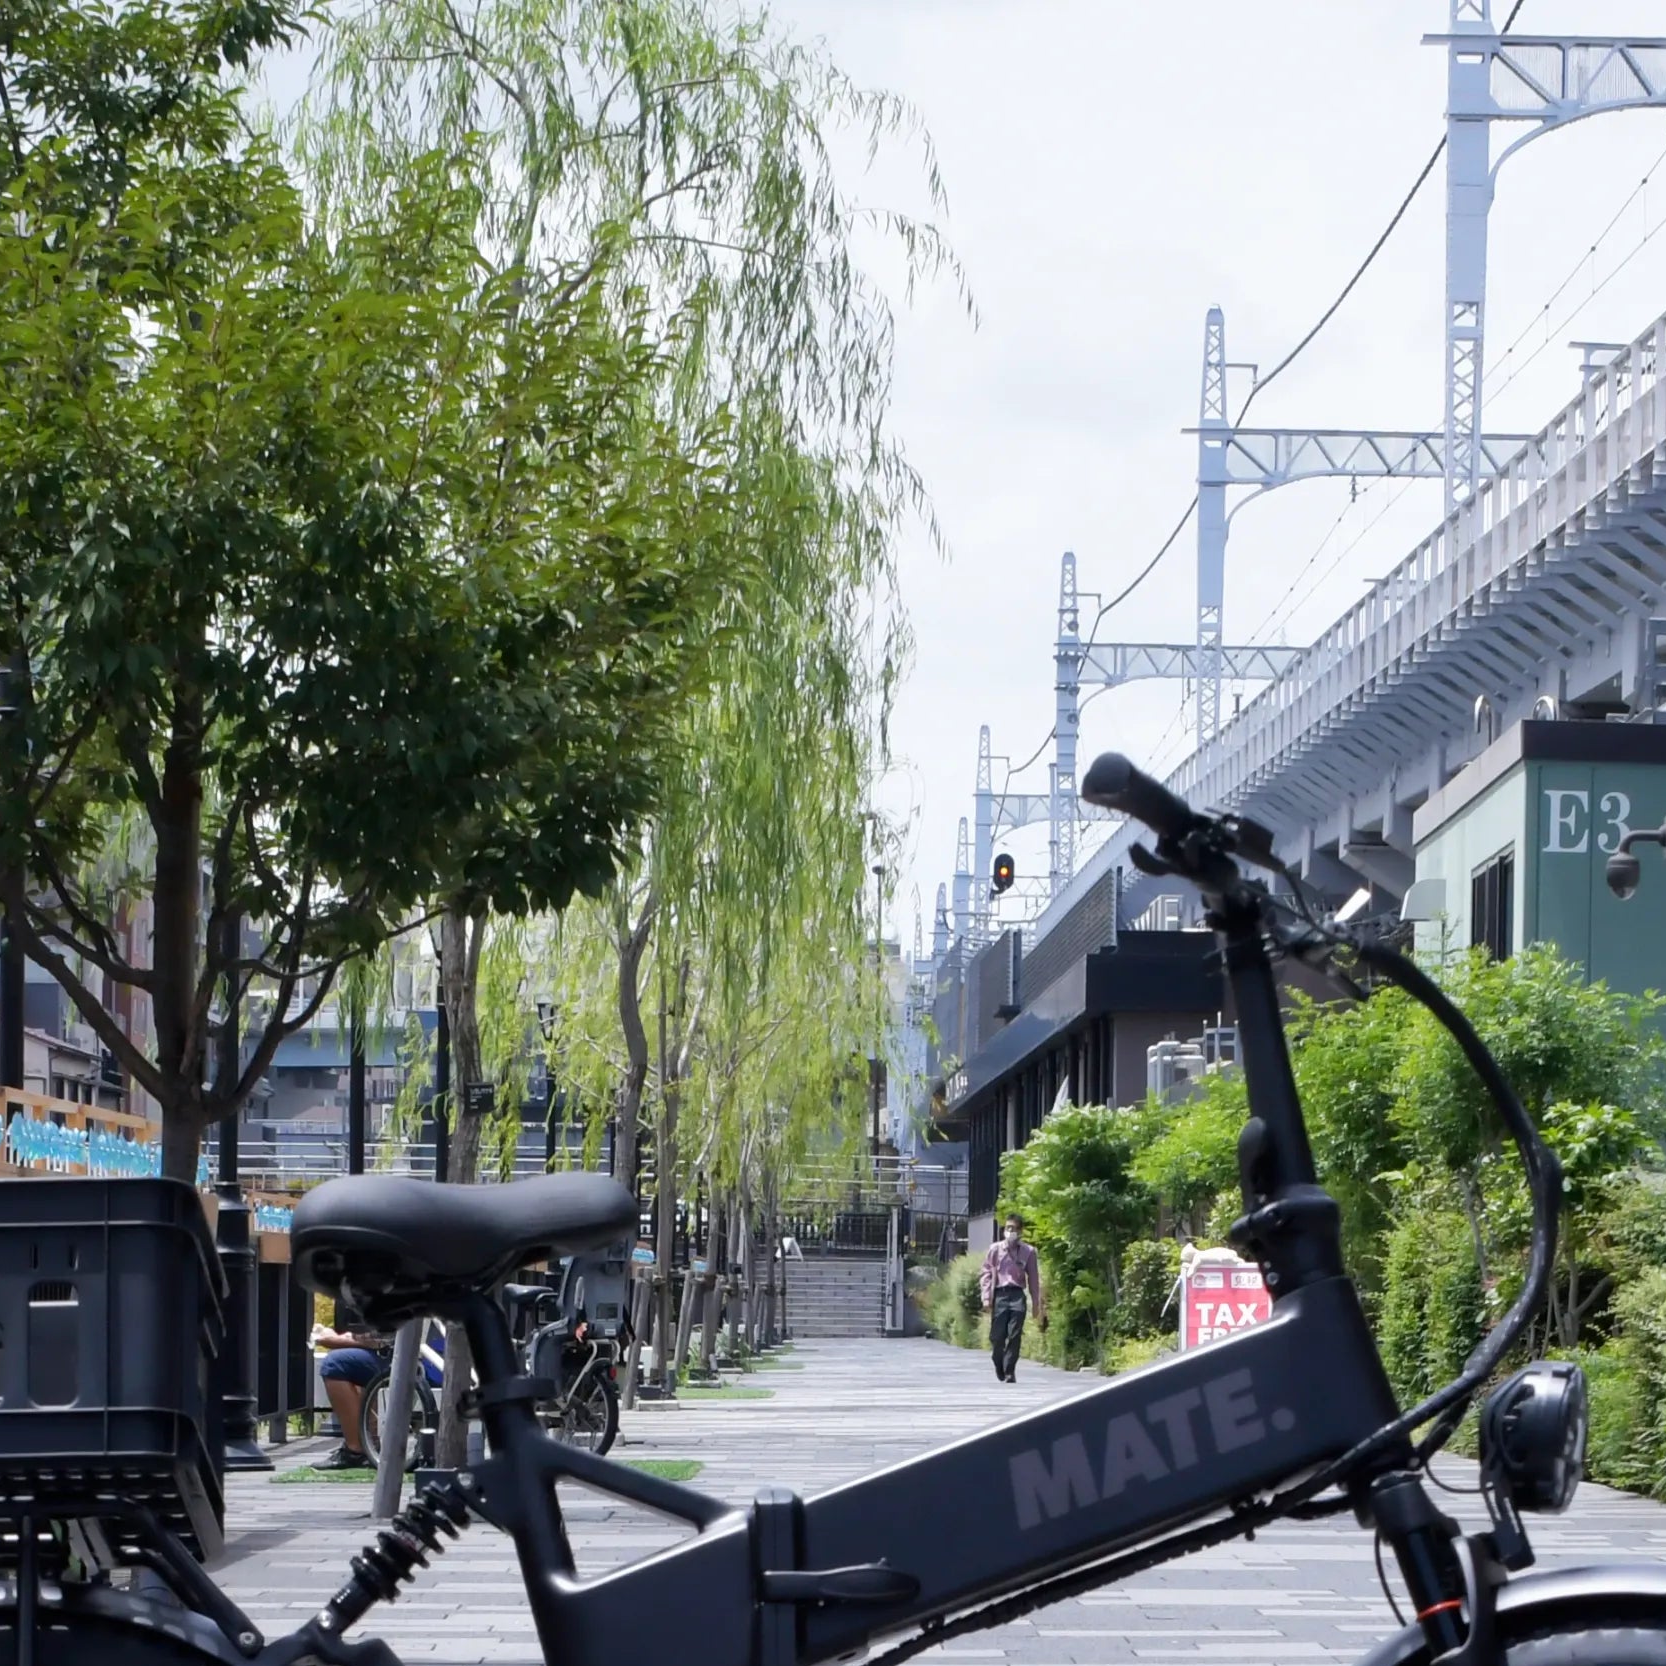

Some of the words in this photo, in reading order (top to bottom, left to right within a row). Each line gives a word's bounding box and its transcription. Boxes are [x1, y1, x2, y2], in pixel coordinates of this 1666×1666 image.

[1542, 790, 1632, 853] E3
[1195, 1303, 1257, 1326] TAX
[1009, 1368, 1296, 1531] MATE.
